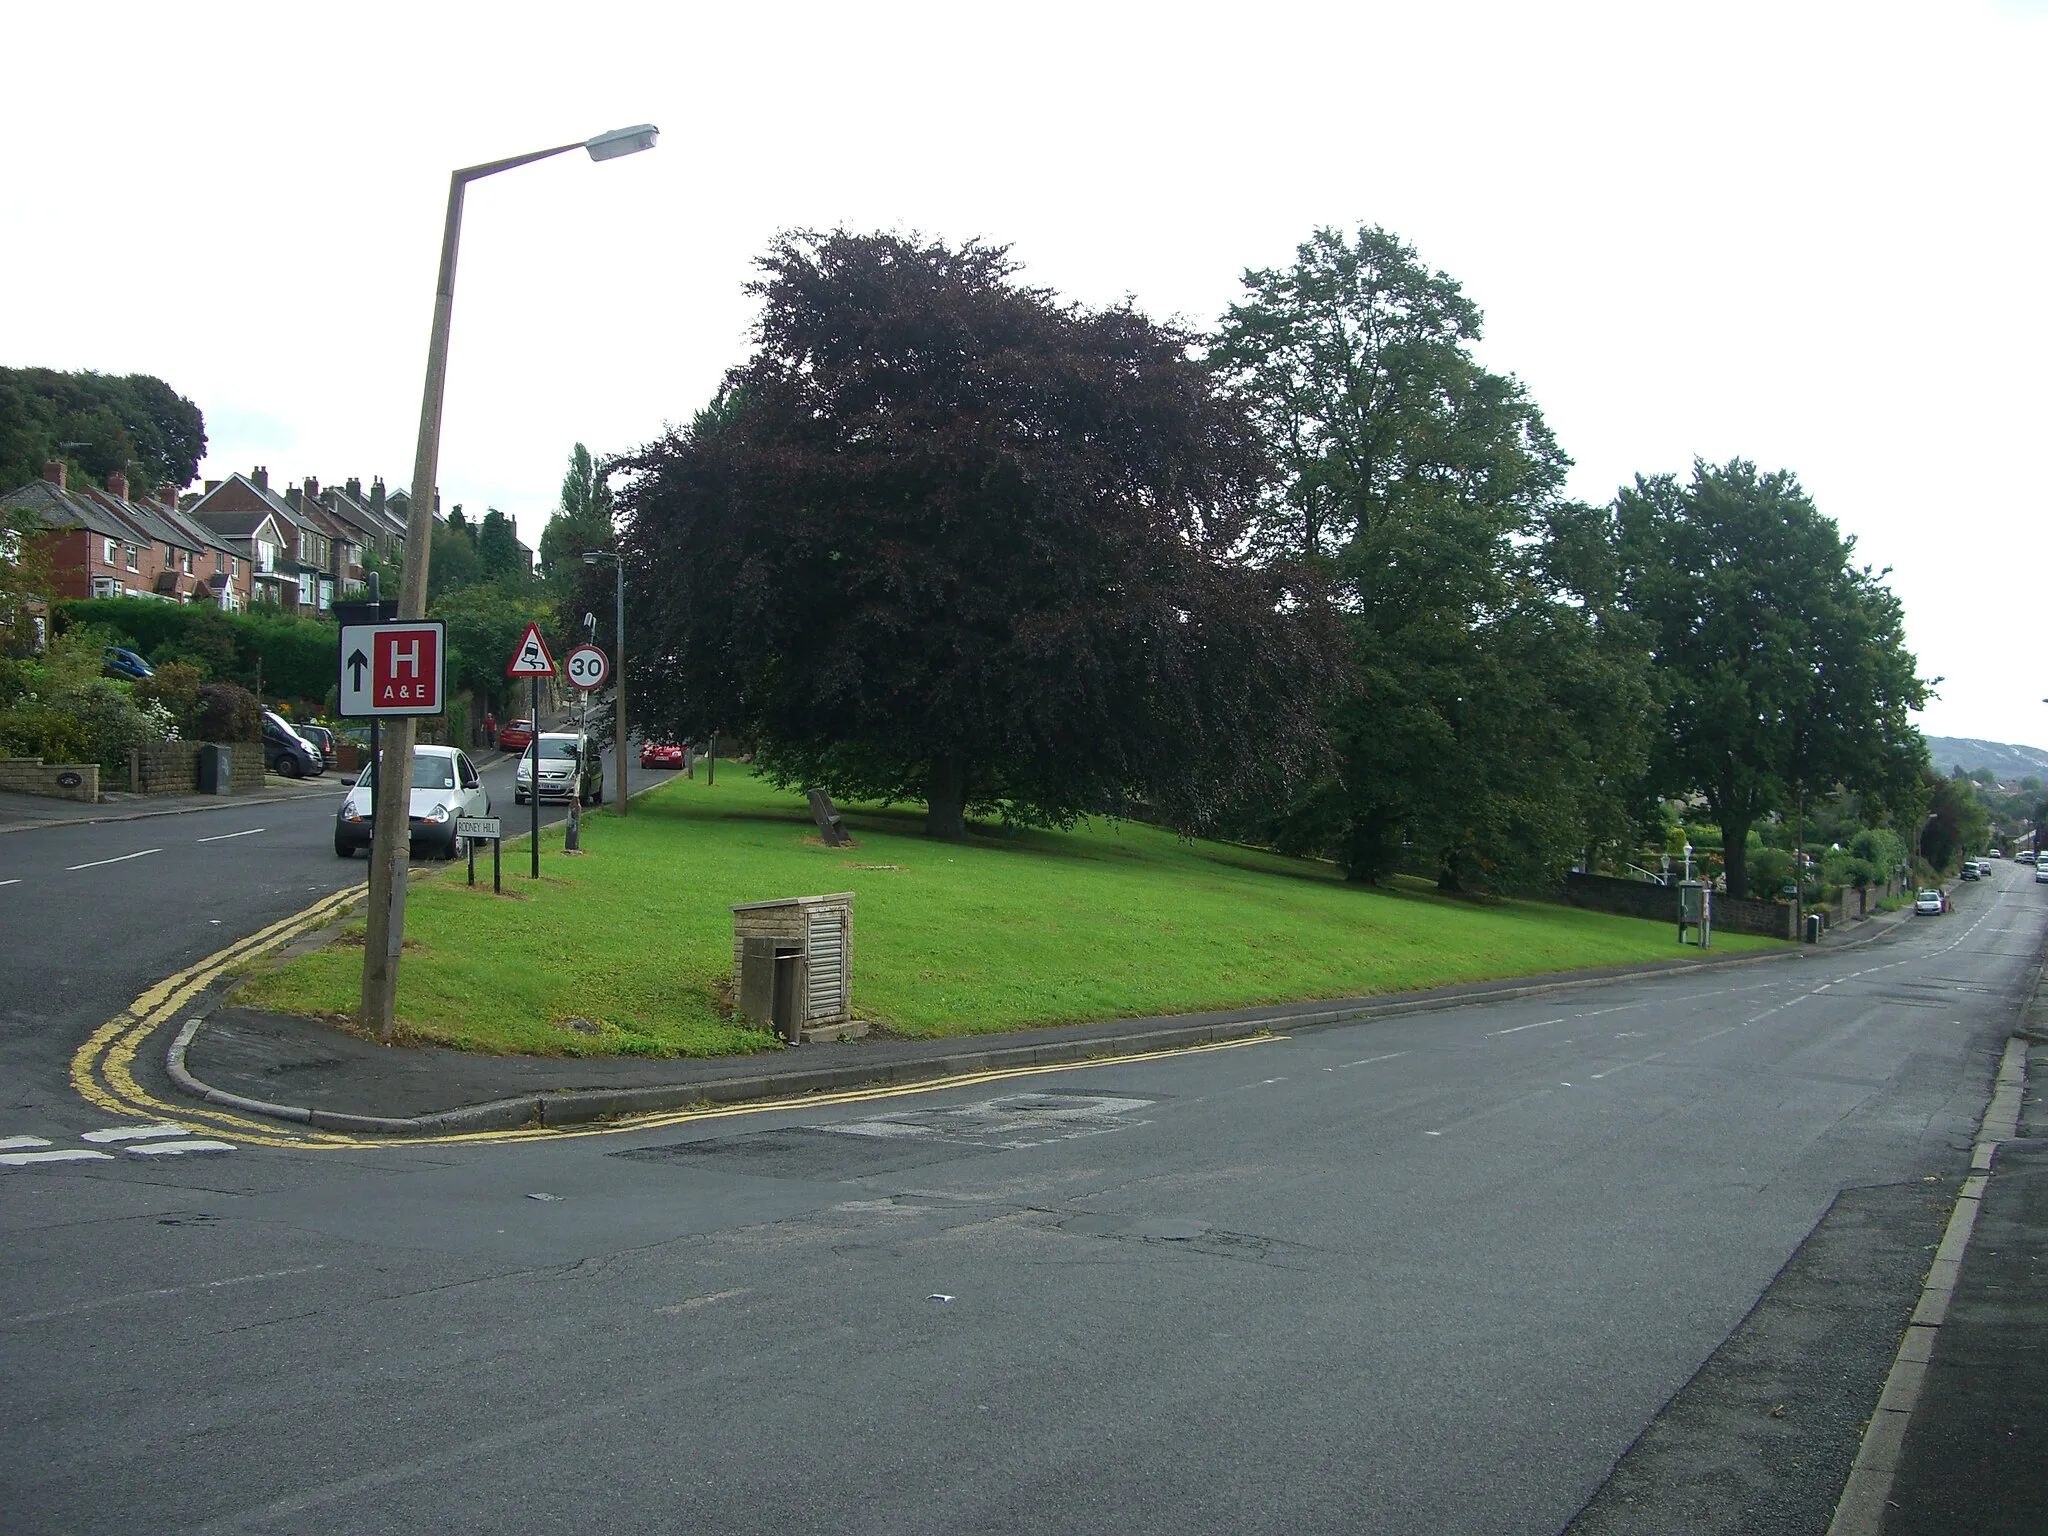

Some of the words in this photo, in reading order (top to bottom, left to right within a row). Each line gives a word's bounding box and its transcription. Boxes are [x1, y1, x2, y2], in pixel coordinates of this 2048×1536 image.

[390, 639, 419, 679] H
[571, 658, 602, 677] 30
[458, 821, 480, 833] RODNEY
[483, 822, 495, 833] HILL
